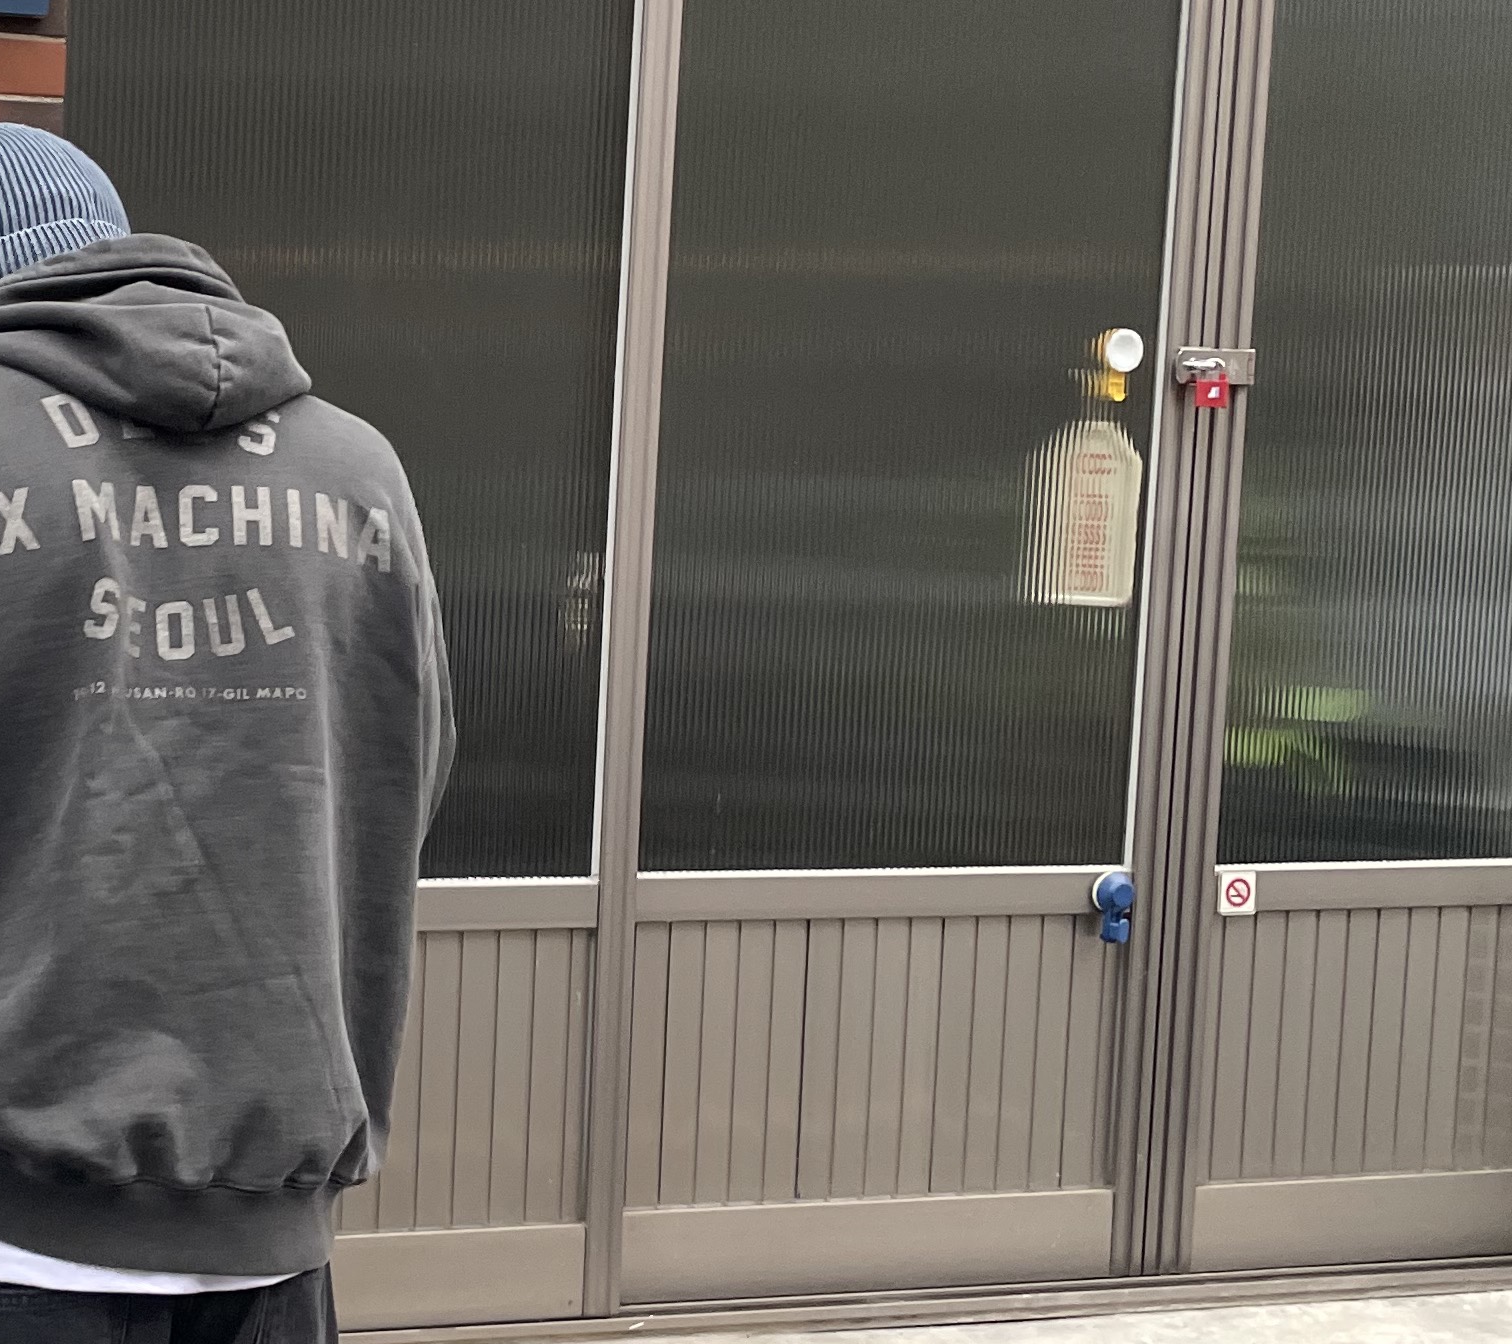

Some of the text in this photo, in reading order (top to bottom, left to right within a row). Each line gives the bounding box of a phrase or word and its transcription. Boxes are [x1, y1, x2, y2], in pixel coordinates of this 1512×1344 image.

[41, 393, 281, 456] DS
[72, 479, 391, 572] MACHINA
[83, 577, 296, 661] SEOUL
[256, 687, 307, 700] MAPO
